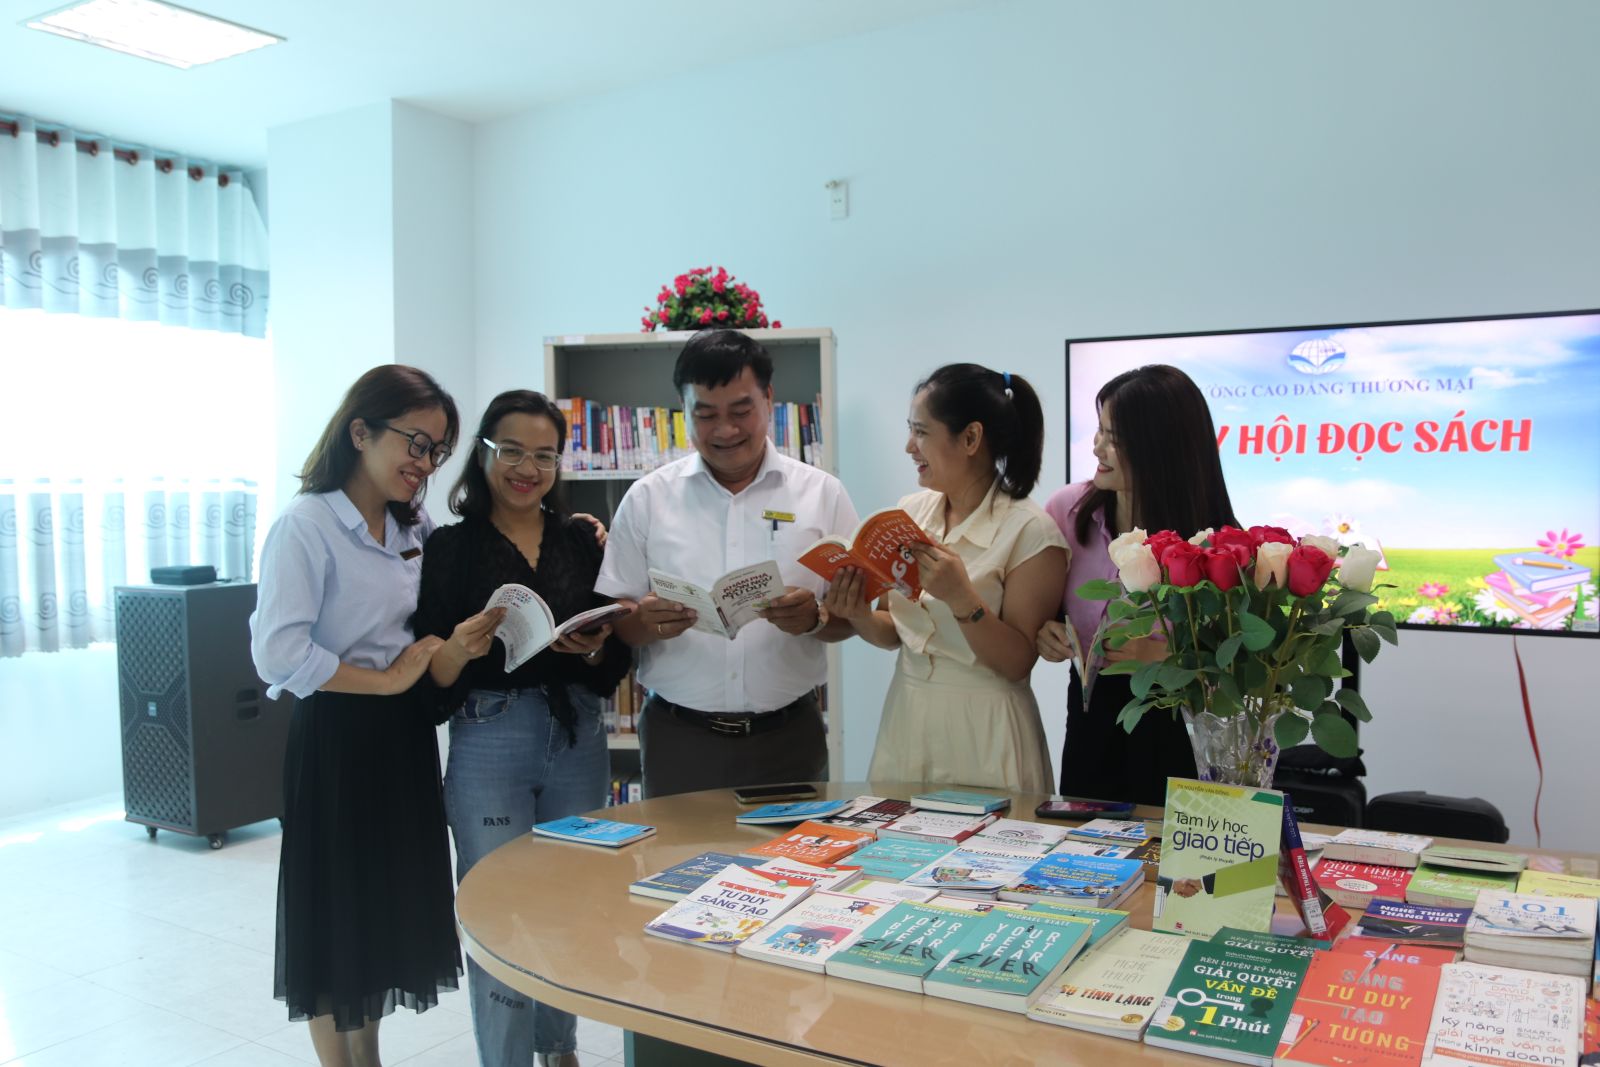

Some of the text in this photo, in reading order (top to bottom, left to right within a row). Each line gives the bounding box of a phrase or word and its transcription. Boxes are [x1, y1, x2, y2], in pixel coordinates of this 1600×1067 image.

[1251, 383, 1289, 397] CAO
[1238, 414, 1308, 462] HỘI
[1316, 421, 1404, 461] ĐỌC
[1412, 410, 1533, 453] SÁCH
[483, 816, 511, 827] FANS
[1222, 818, 1249, 838] học
[1172, 827, 1265, 863] giao tiếp
[739, 893, 771, 905] DUY
[1499, 900, 1568, 917] 101
[901, 914, 963, 931] YOUR
[1006, 912, 1041, 923] MICHAEL
[880, 930, 944, 948] YEAR
[889, 922, 954, 939] BEST
[996, 923, 1061, 942] YOUR
[854, 938, 937, 960] EVER
[984, 932, 1054, 951] BEST
[977, 943, 1043, 963] YEAR
[951, 953, 1041, 977] EVER
[1193, 963, 1297, 989] GIẢI QUYẾT
[1205, 978, 1279, 1000] VẤN ĐỀ
[1216, 991, 1242, 1003] trong
[1363, 990, 1414, 1010] DUY
[1194, 1005, 1271, 1035] 1 Phút
[1464, 1041, 1501, 1057] kinh
[1506, 1049, 1565, 1065] doanh
